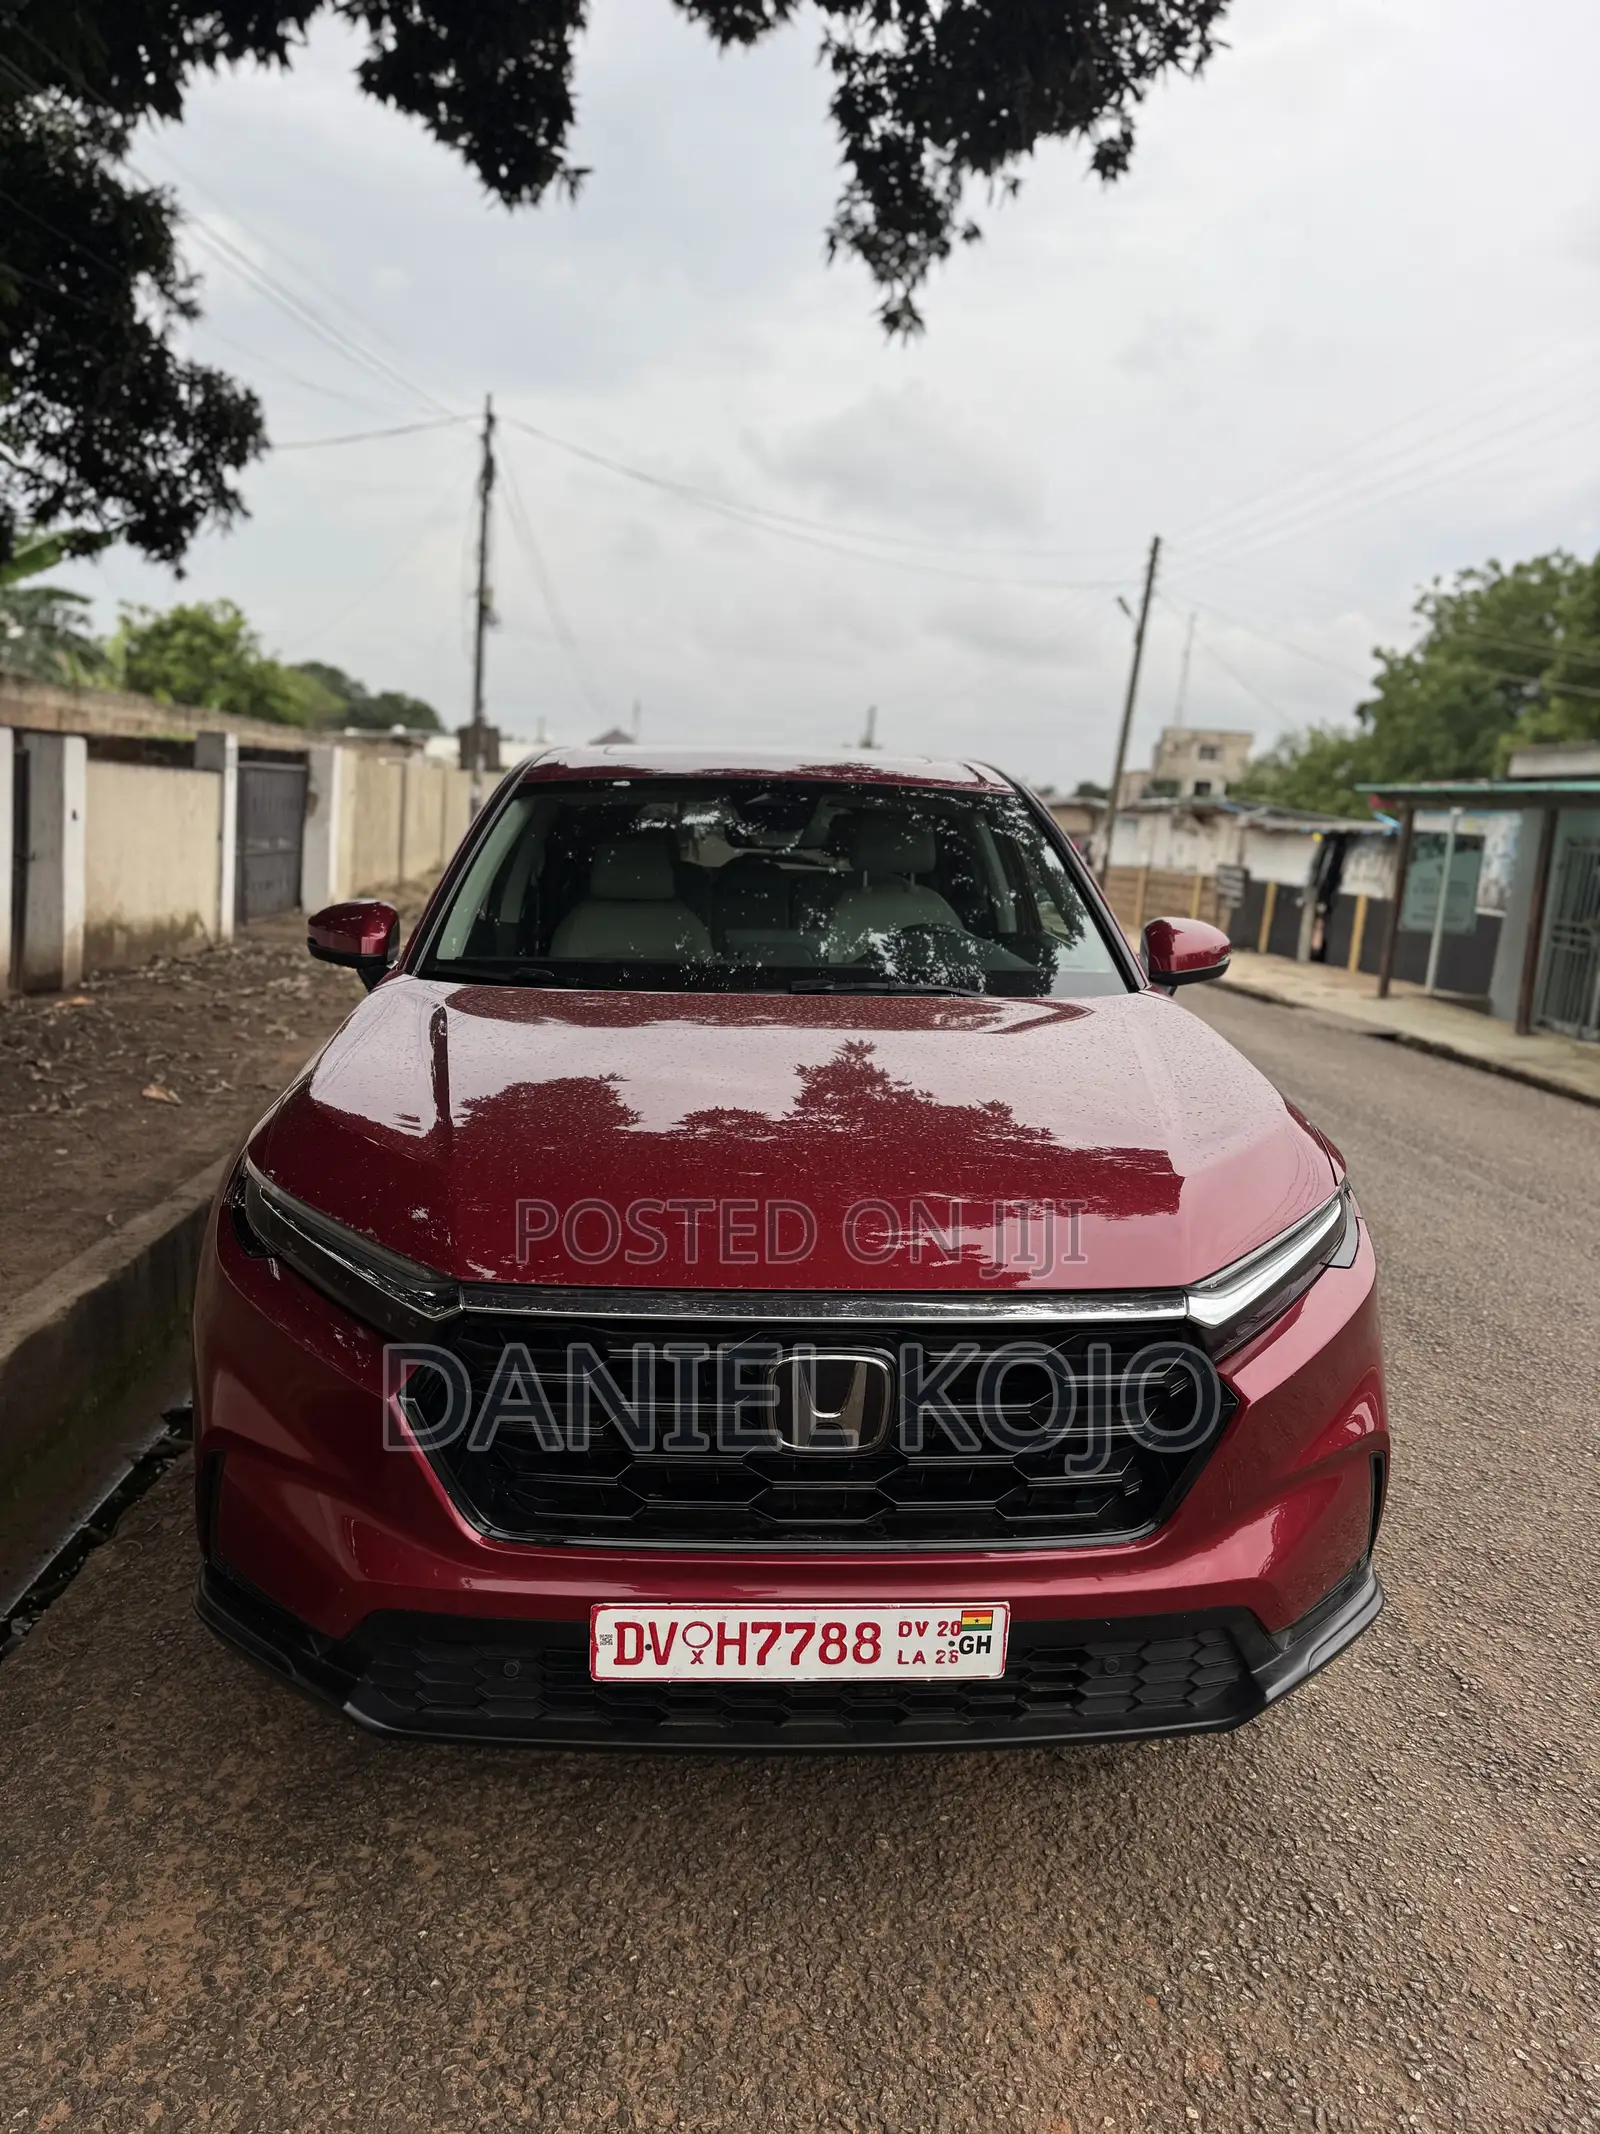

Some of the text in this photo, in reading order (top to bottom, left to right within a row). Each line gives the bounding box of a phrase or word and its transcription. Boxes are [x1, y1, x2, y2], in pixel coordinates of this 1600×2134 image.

[898, 1621, 961, 1637] DV 20
[959, 1635, 992, 1655] GH
[897, 1650, 926, 1665] LA
